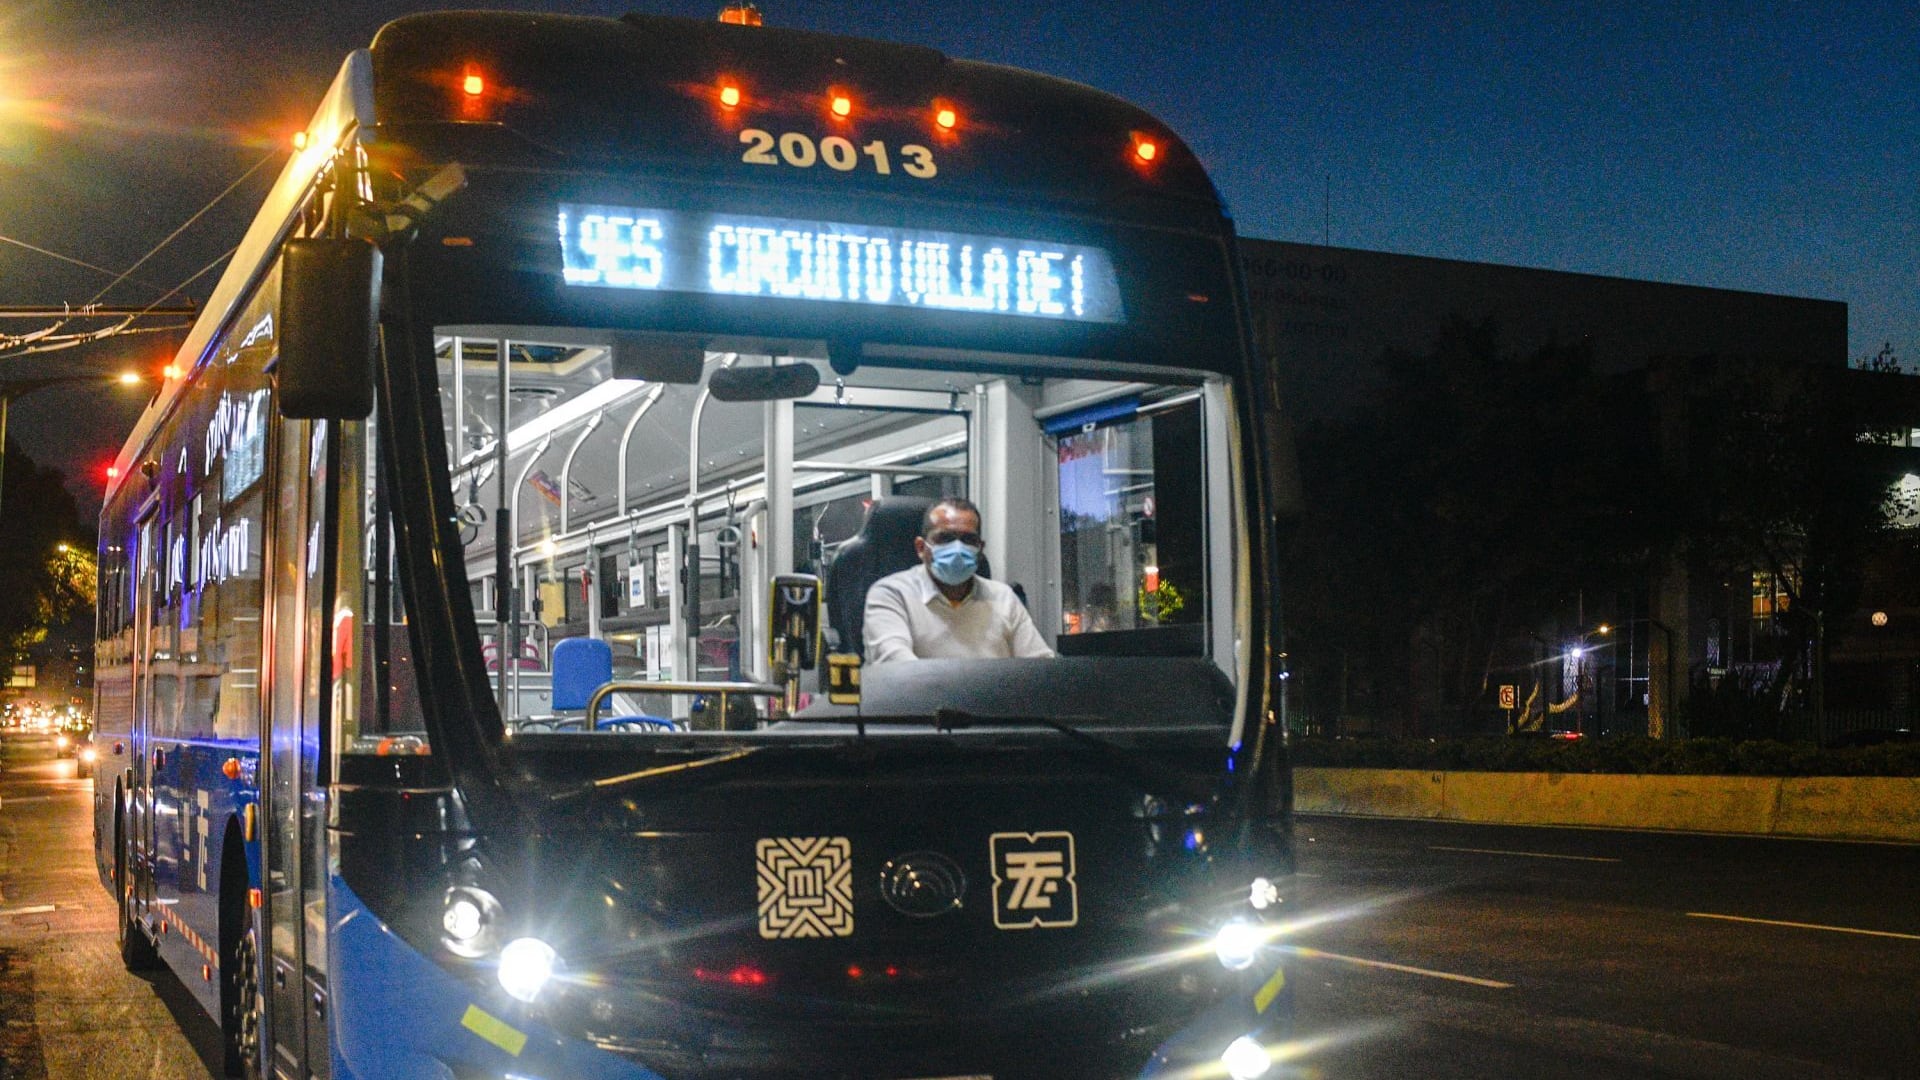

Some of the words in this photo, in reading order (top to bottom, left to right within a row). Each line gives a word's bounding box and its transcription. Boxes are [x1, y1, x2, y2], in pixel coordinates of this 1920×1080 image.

[739, 129, 938, 179] 20013
[709, 225, 892, 302] CIRCUITO
[900, 240, 1009, 311] VILLA
